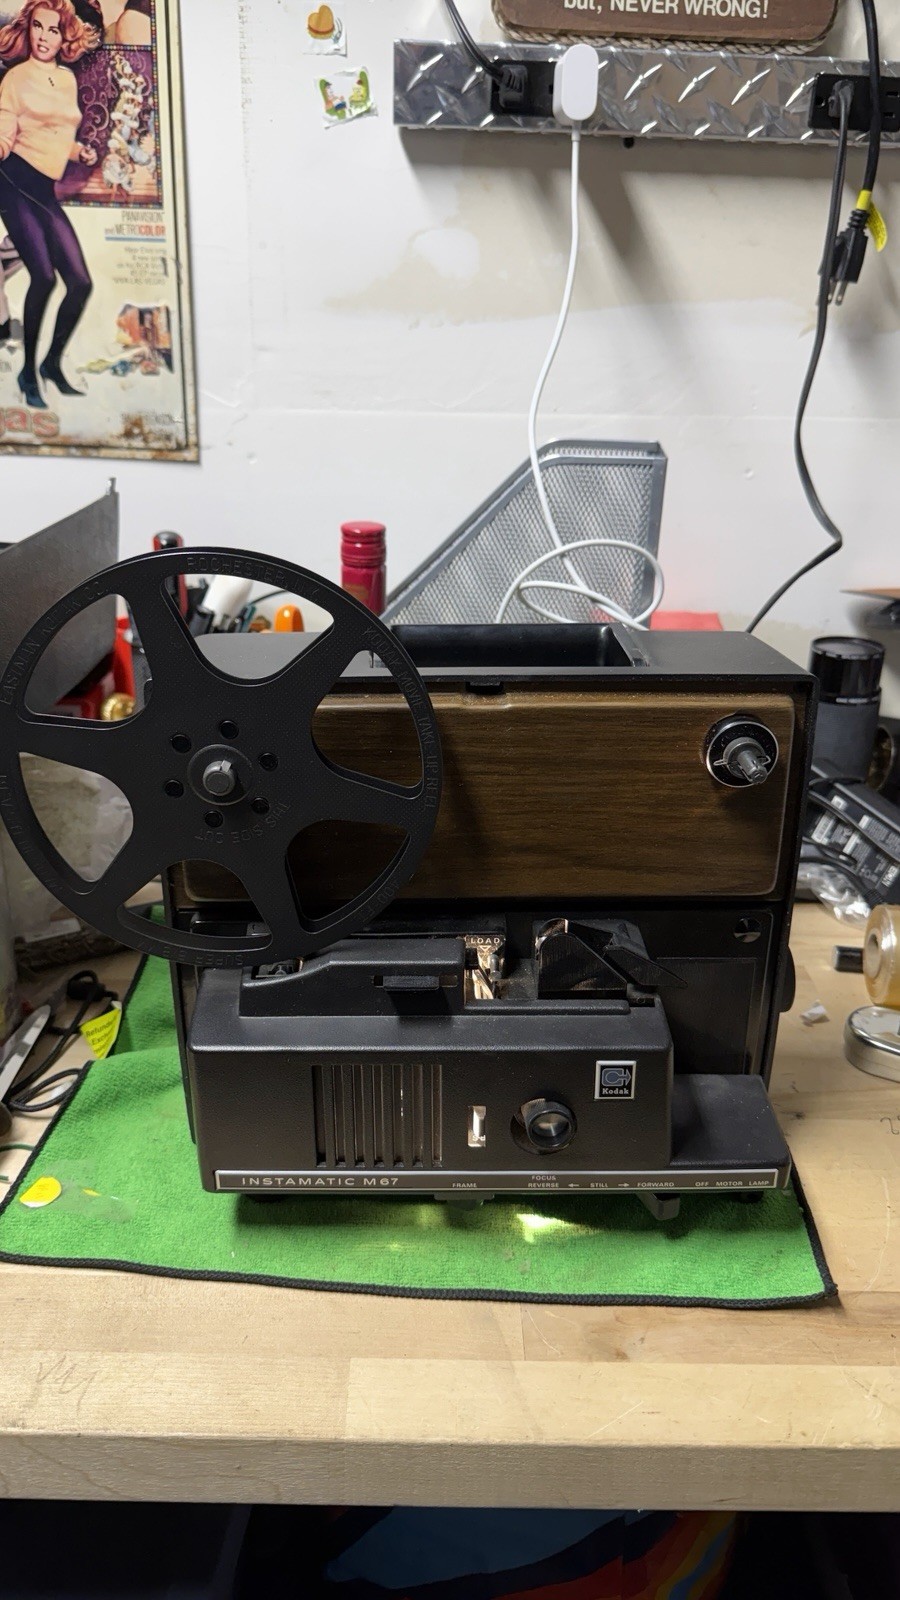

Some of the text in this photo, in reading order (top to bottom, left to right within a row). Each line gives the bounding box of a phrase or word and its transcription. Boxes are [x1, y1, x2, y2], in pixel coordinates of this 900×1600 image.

[563, 0, 768, 19] but, NEVER WRONG!
[0, 407, 60, 438] as
[602, 1087, 629, 1095] Kodak
[241, 1177, 399, 1186] INSTAMATIC M67
[748, 1179, 770, 1187] LAMP
